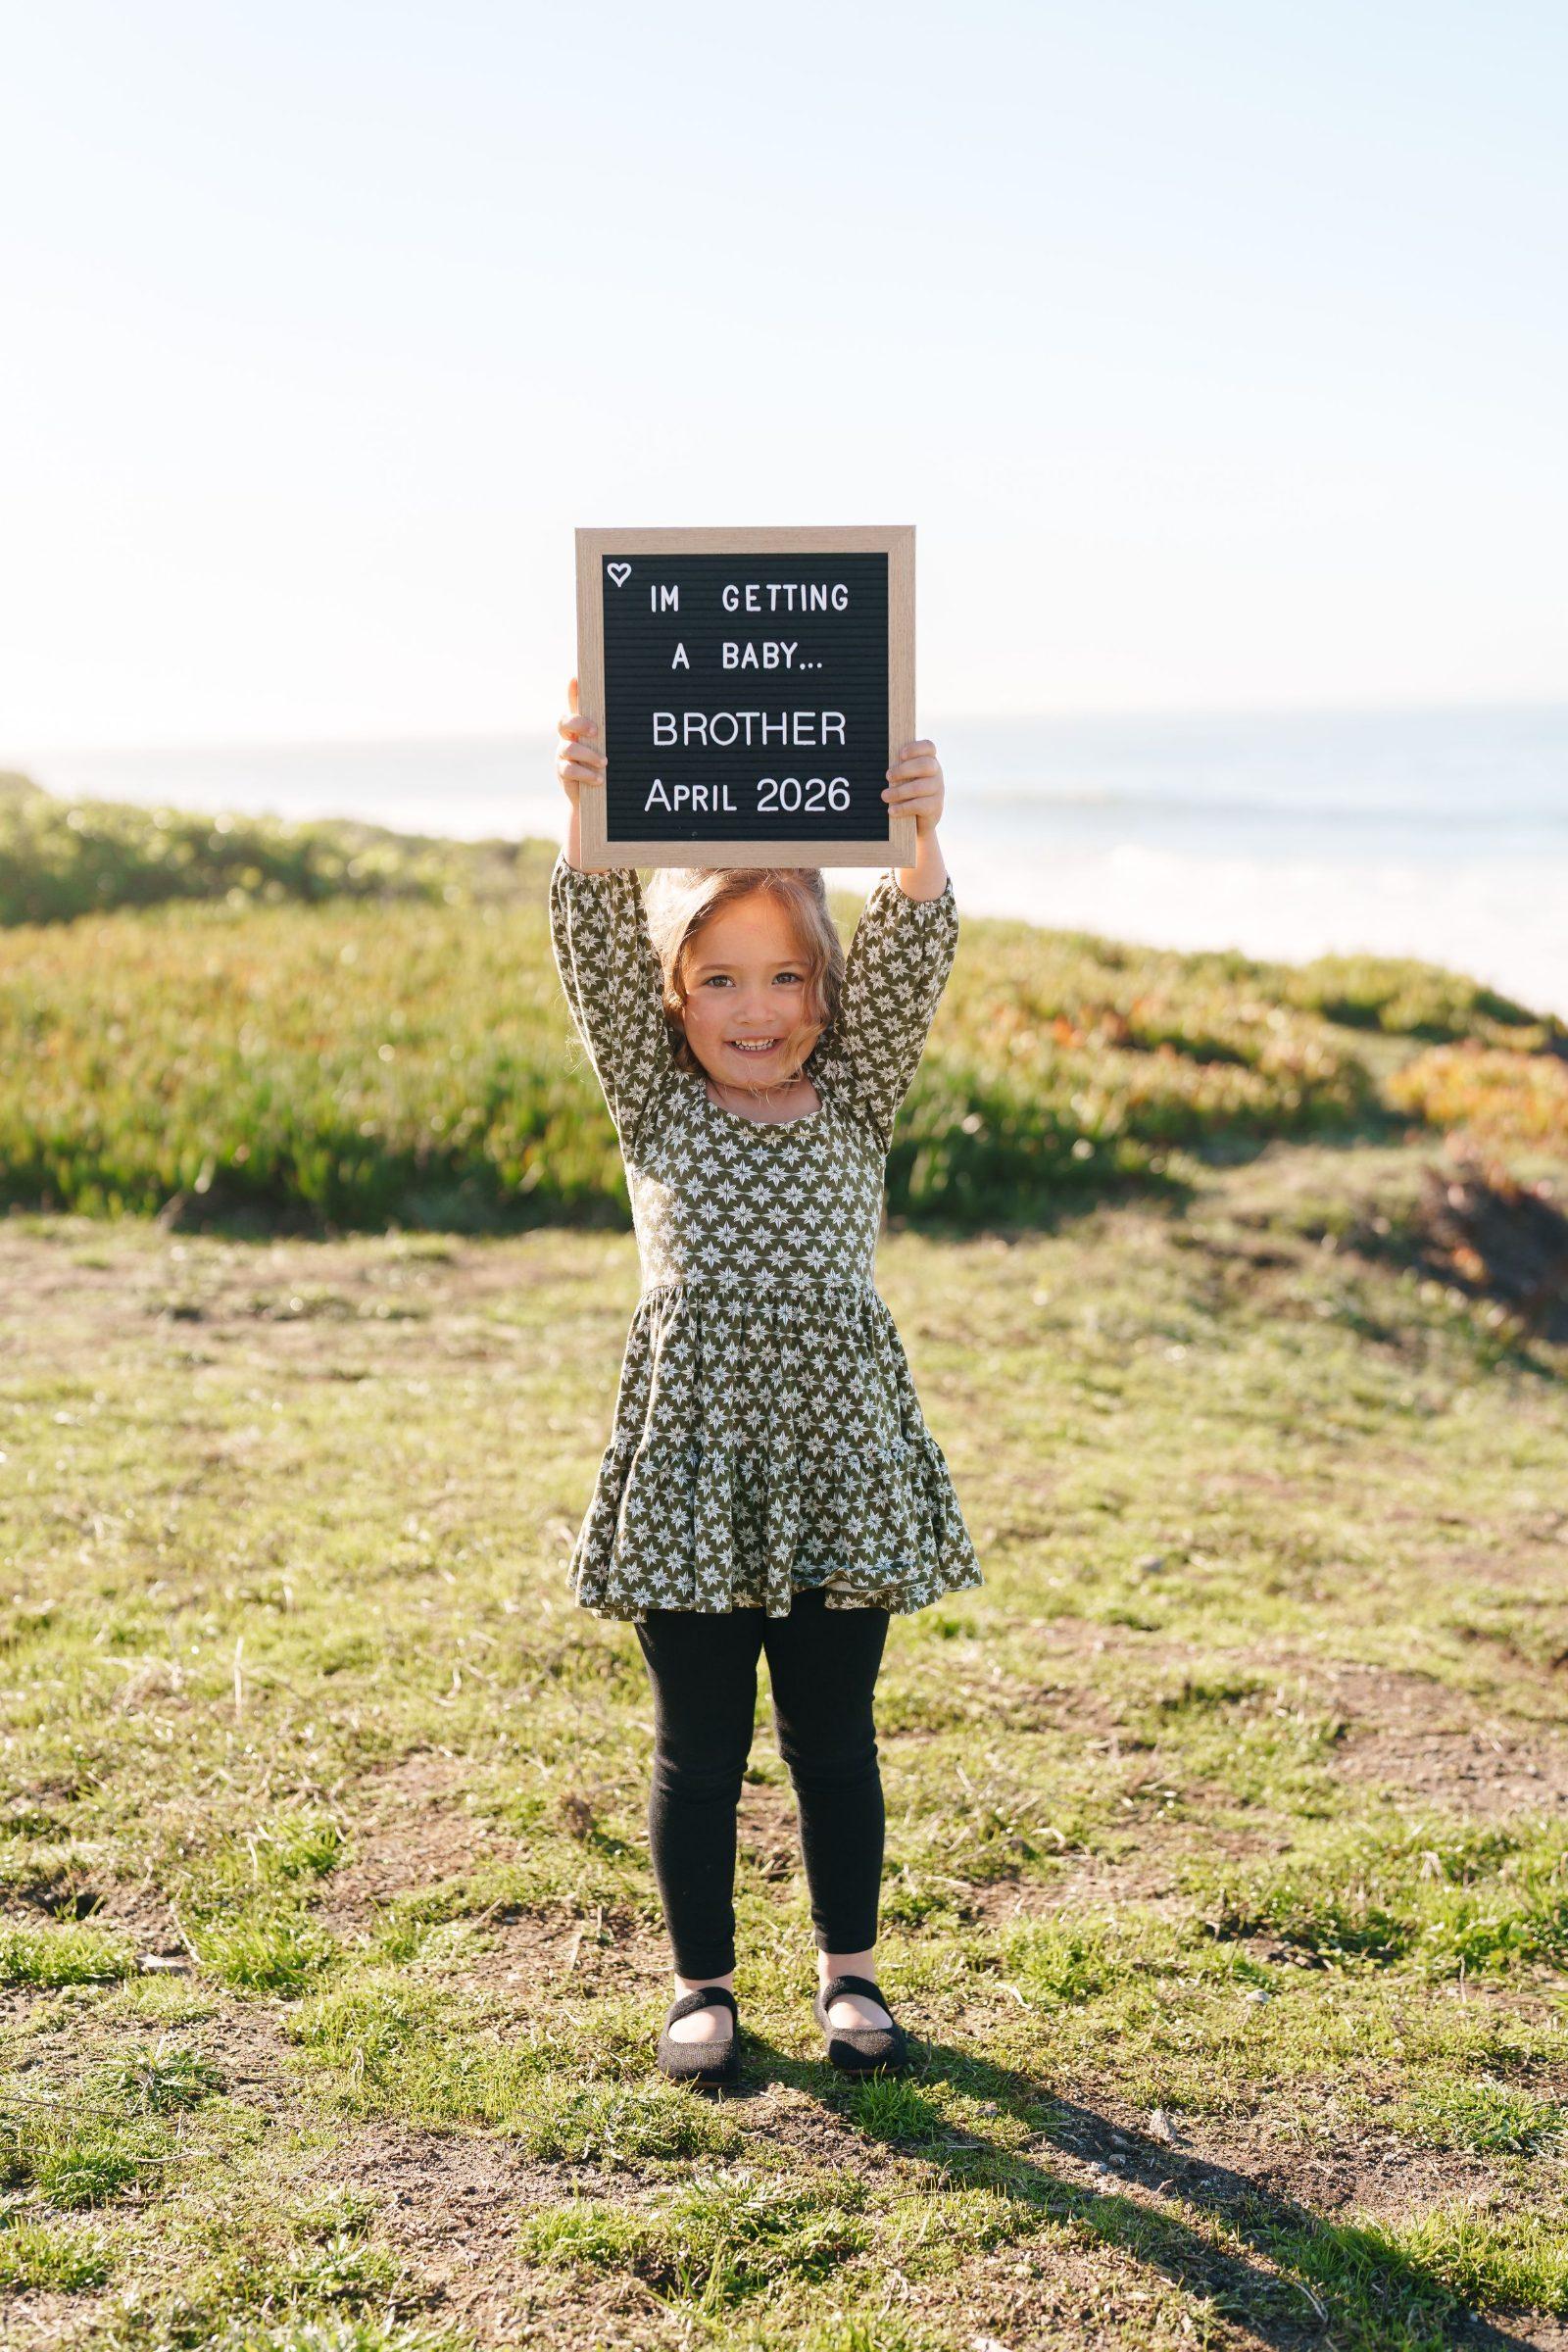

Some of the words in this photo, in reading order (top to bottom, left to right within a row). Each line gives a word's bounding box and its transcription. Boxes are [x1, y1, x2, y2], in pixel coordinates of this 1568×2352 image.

[651, 584, 679, 612] IM
[721, 583, 849, 612] GETTING
[671, 642, 690, 670] A
[722, 641, 823, 670] BABY...
[653, 710, 846, 747] BROTHER
[757, 776, 851, 812] 2026
